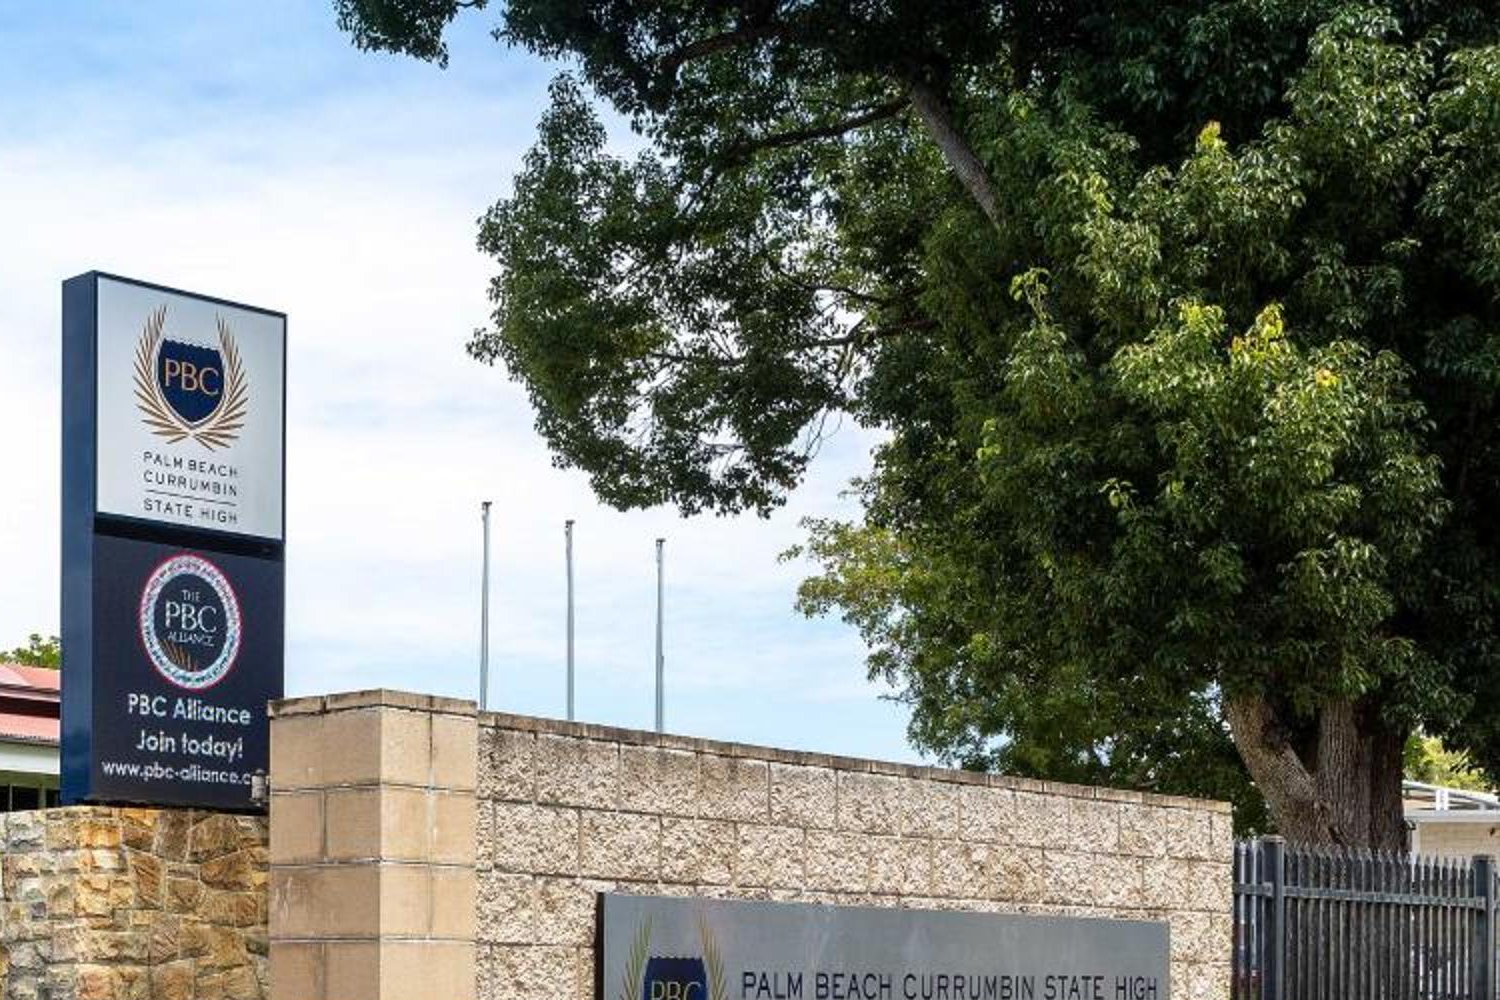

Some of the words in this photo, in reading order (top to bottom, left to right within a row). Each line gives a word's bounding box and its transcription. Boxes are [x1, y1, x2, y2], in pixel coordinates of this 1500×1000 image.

[164, 358, 219, 395] PBC
[143, 451, 183, 469] PALM
[188, 459, 238, 477] BEACH
[143, 469, 237, 497] CURRUMBIN
[143, 498, 193, 518] STATE
[200, 507, 237, 524] HIGH
[181, 589, 200, 602] THE
[165, 600, 217, 633] PBC
[128, 693, 167, 717] PBC
[173, 697, 251, 725] Alliance
[136, 729, 176, 753] Join
[181, 732, 243, 764] today!
[101, 761, 271, 785] www.pbc-alliance.c
[741, 971, 803, 1000] PALM
[815, 972, 893, 1000] BEACH
[903, 973, 1035, 1000] CURRUMBIN
[1044, 974, 1105, 1000] STATE
[1115, 975, 1157, 1000] HIGH
